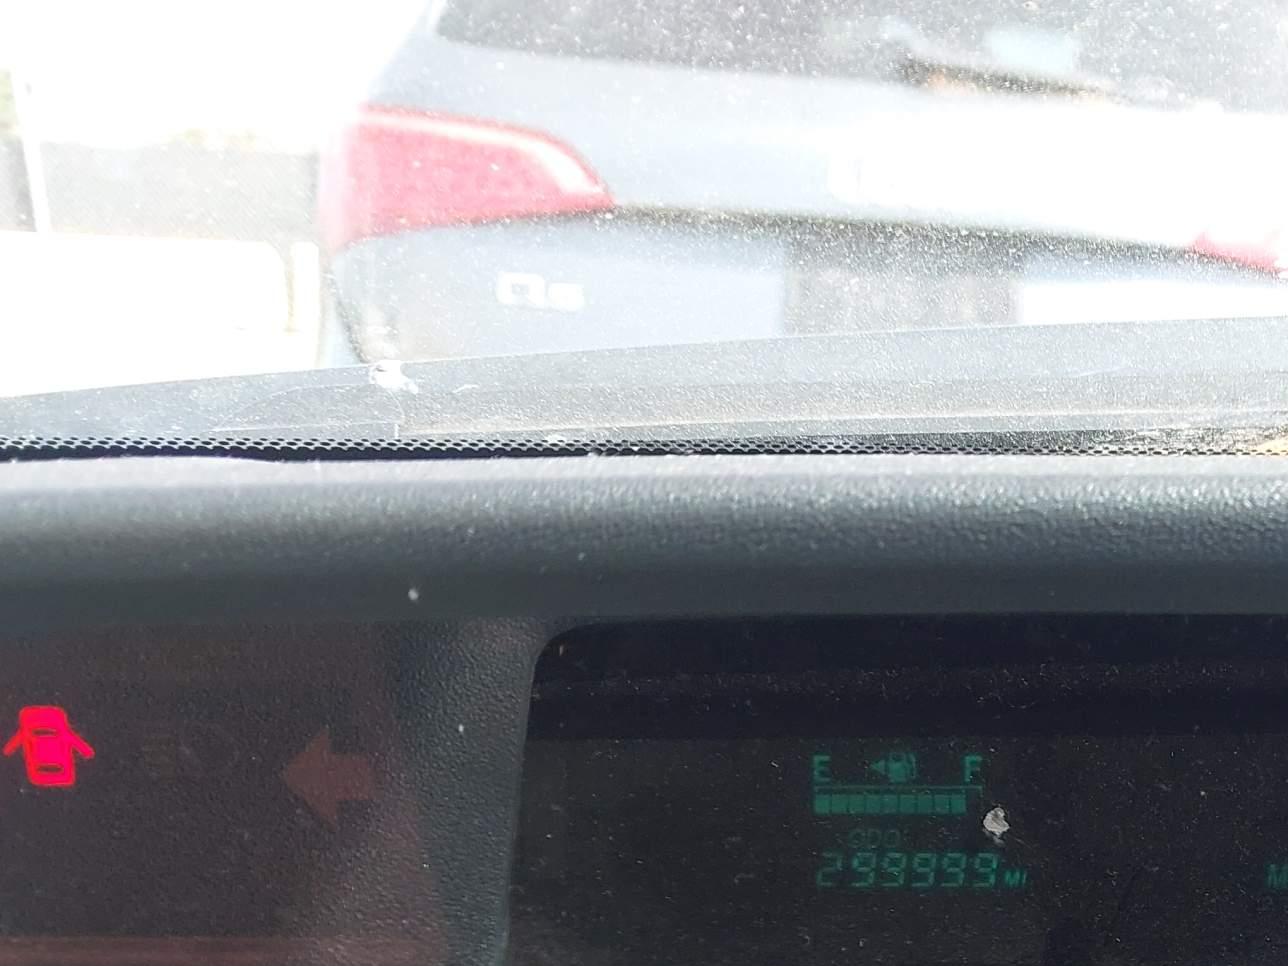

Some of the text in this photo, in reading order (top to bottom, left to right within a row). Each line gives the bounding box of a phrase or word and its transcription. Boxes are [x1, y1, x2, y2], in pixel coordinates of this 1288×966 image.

[814, 754, 983, 783] E F
[816, 851, 1001, 888] 299999
